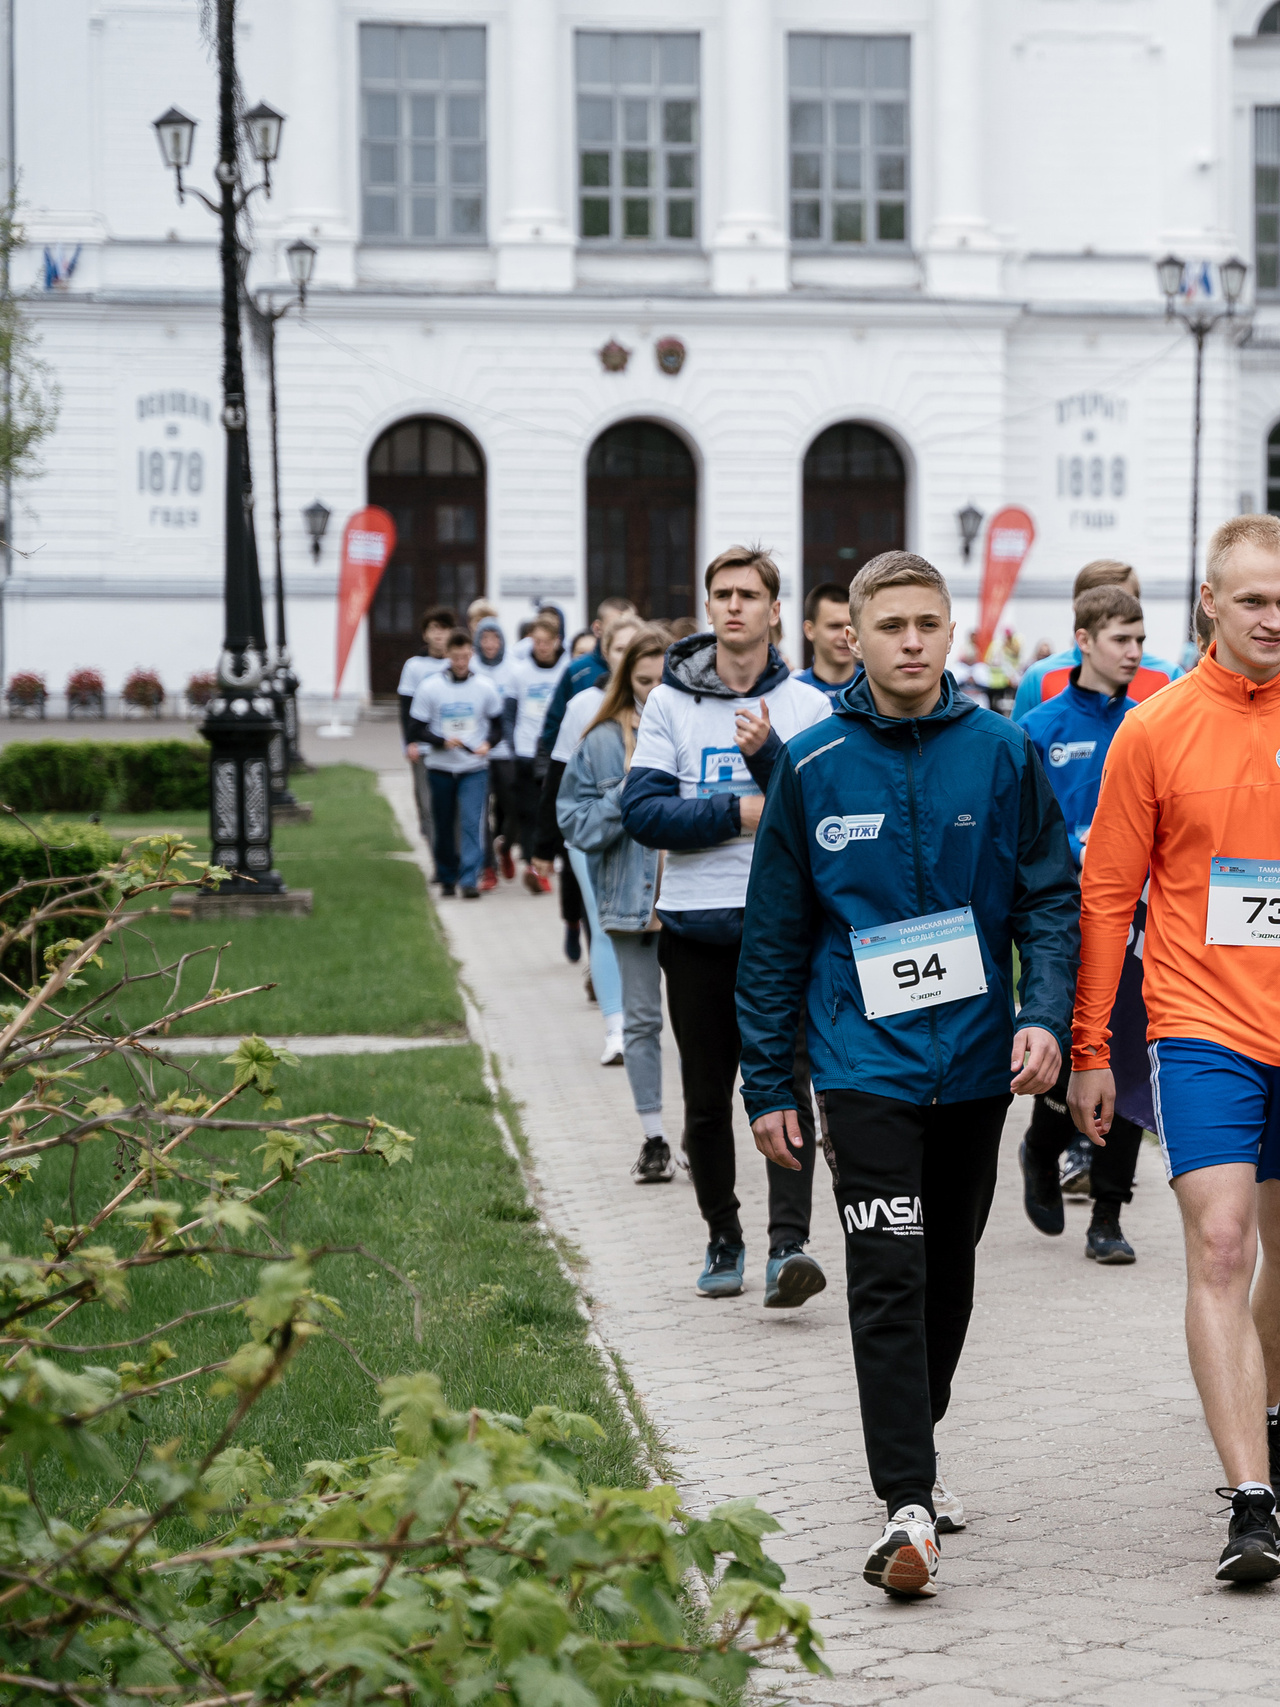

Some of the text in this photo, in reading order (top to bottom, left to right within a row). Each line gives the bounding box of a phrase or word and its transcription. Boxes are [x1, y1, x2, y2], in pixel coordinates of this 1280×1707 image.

[138, 448, 203, 494] 1878
[1057, 454, 1127, 499] 1888
[718, 755, 743, 764] LOVE
[849, 827, 878, 838] ТТЖТ
[898, 915, 965, 935] ТАМАНСКАЯ МИЛЯ
[907, 932, 935, 943] СЕРДЦЕ
[935, 925, 965, 937] СИБИРИ
[892, 953, 947, 989] 94
